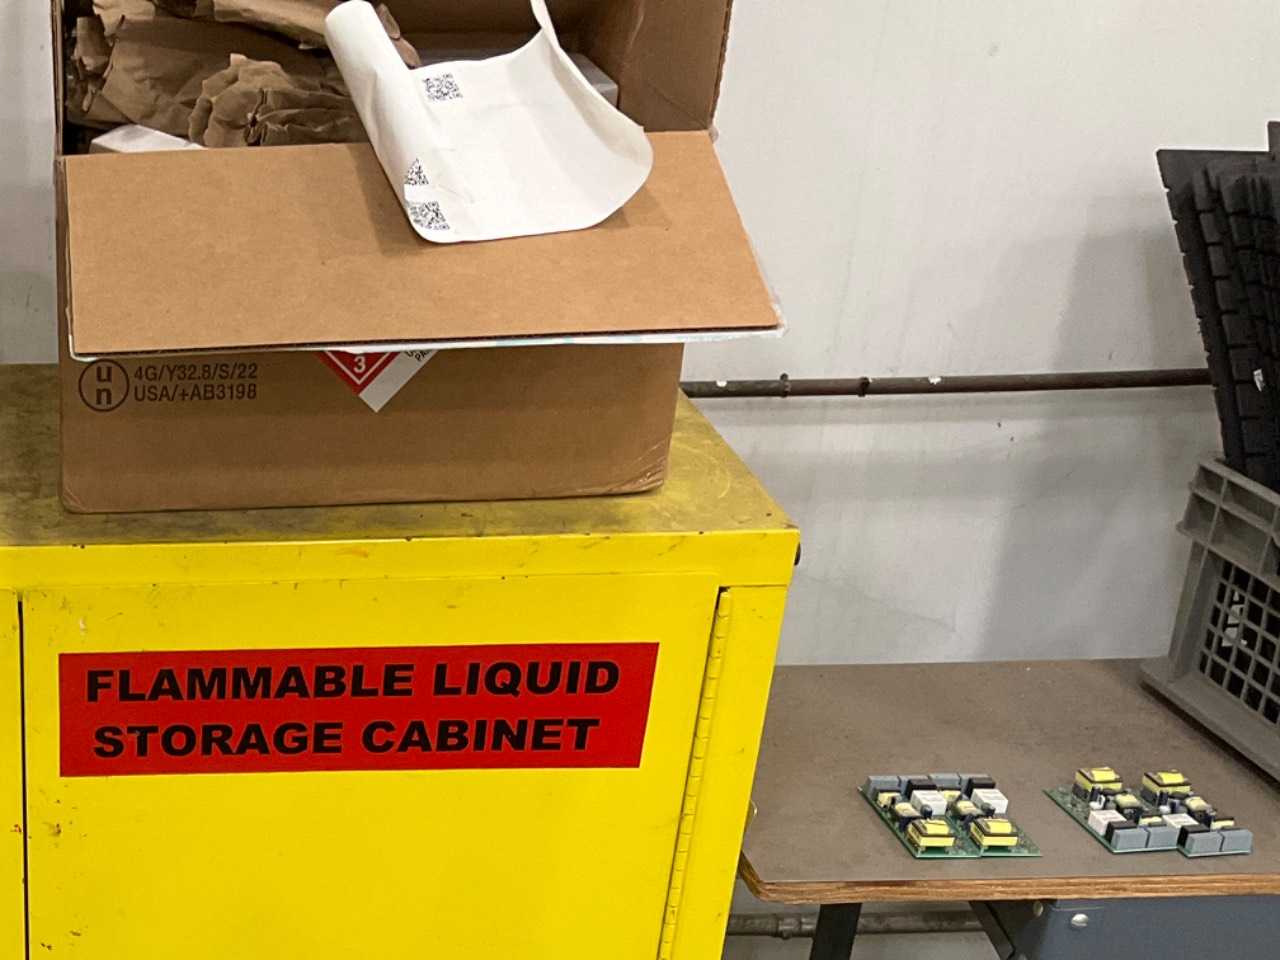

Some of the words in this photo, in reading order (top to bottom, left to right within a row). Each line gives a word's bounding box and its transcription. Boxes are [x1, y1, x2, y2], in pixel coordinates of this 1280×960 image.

[133, 362, 258, 382] 4G/Y32.8/S/22
[353, 355, 366, 373] 3
[133, 383, 257, 401] USA/+AB3198
[87, 663, 415, 703] FLAMMABLE
[433, 660, 620, 698] LIQUID
[93, 722, 343, 759] STORAGE
[362, 718, 600, 753] CABINET
